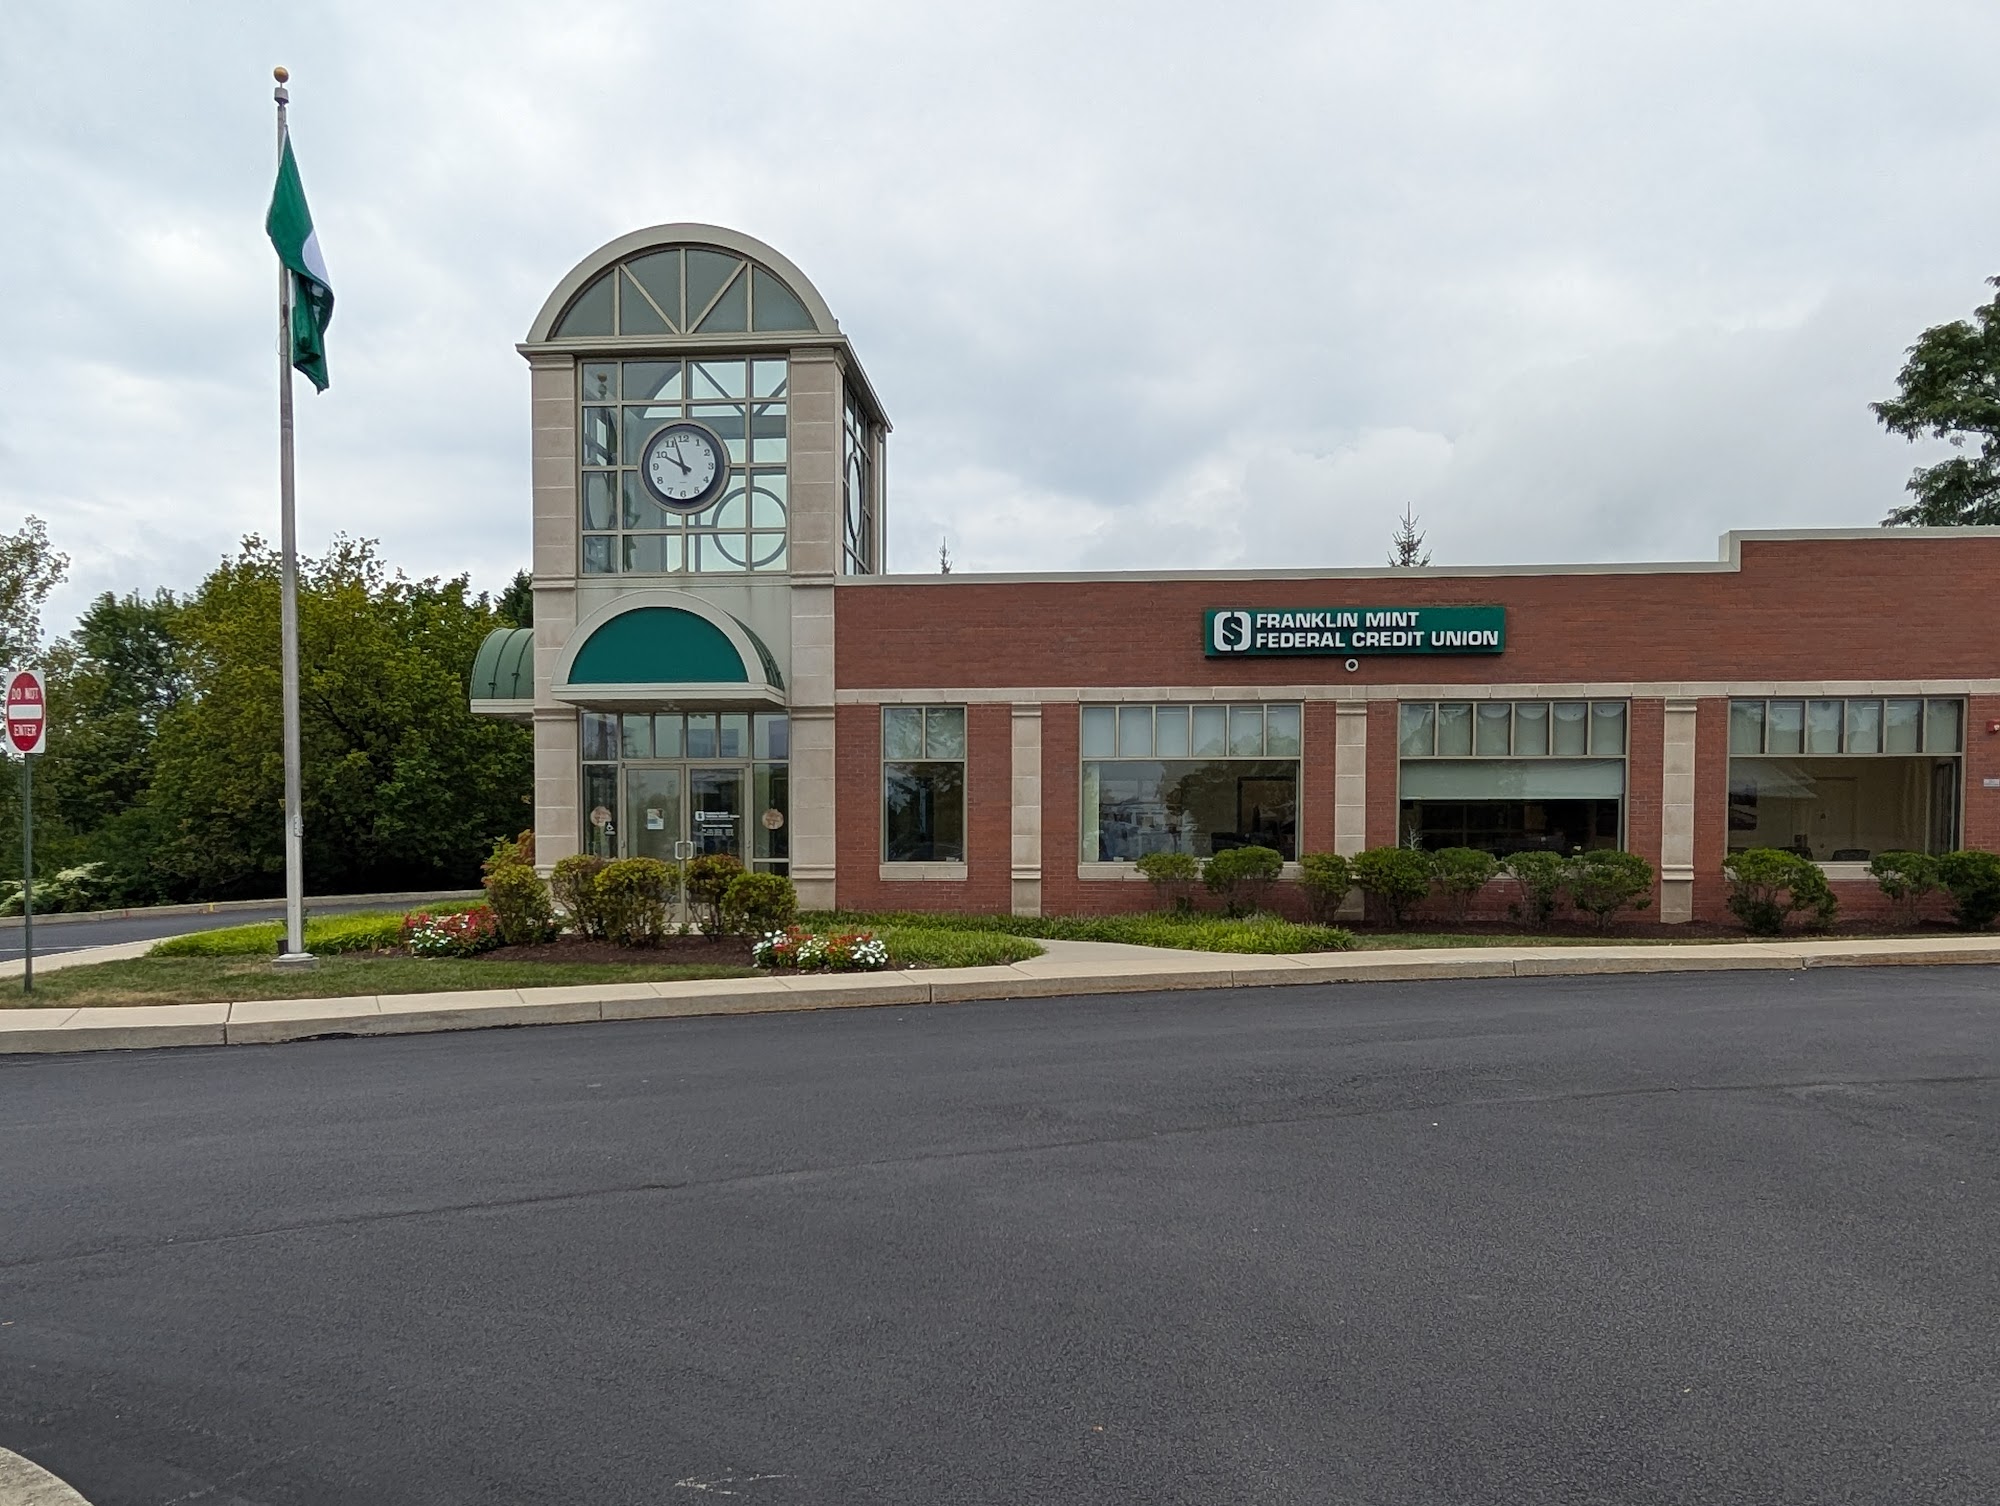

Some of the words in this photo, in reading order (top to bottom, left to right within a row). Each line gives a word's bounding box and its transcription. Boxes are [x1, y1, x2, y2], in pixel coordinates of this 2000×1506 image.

[678, 434, 689, 443] 12
[695, 438, 700, 447] 1
[665, 440, 675, 448] 11
[656, 451, 668, 459] 10
[703, 449, 711, 457] 2
[652, 463, 660, 471] 9
[707, 462, 714, 470] 3
[656, 477, 664, 485] 8
[703, 476, 709, 484] 4
[667, 487, 674, 495] 7
[680, 490, 687, 498] 6
[693, 487, 700, 495] 5
[1255, 612, 1359, 629] FRANKLIN
[1365, 611, 1420, 628] MINT
[1255, 631, 1346, 648] FEDERAL
[1351, 630, 1425, 647] CREDIT
[1431, 630, 1499, 646] UNION
[11, 687, 21, 700] DO
[24, 687, 39, 700] NOT
[13, 724, 37, 736] ENTER
